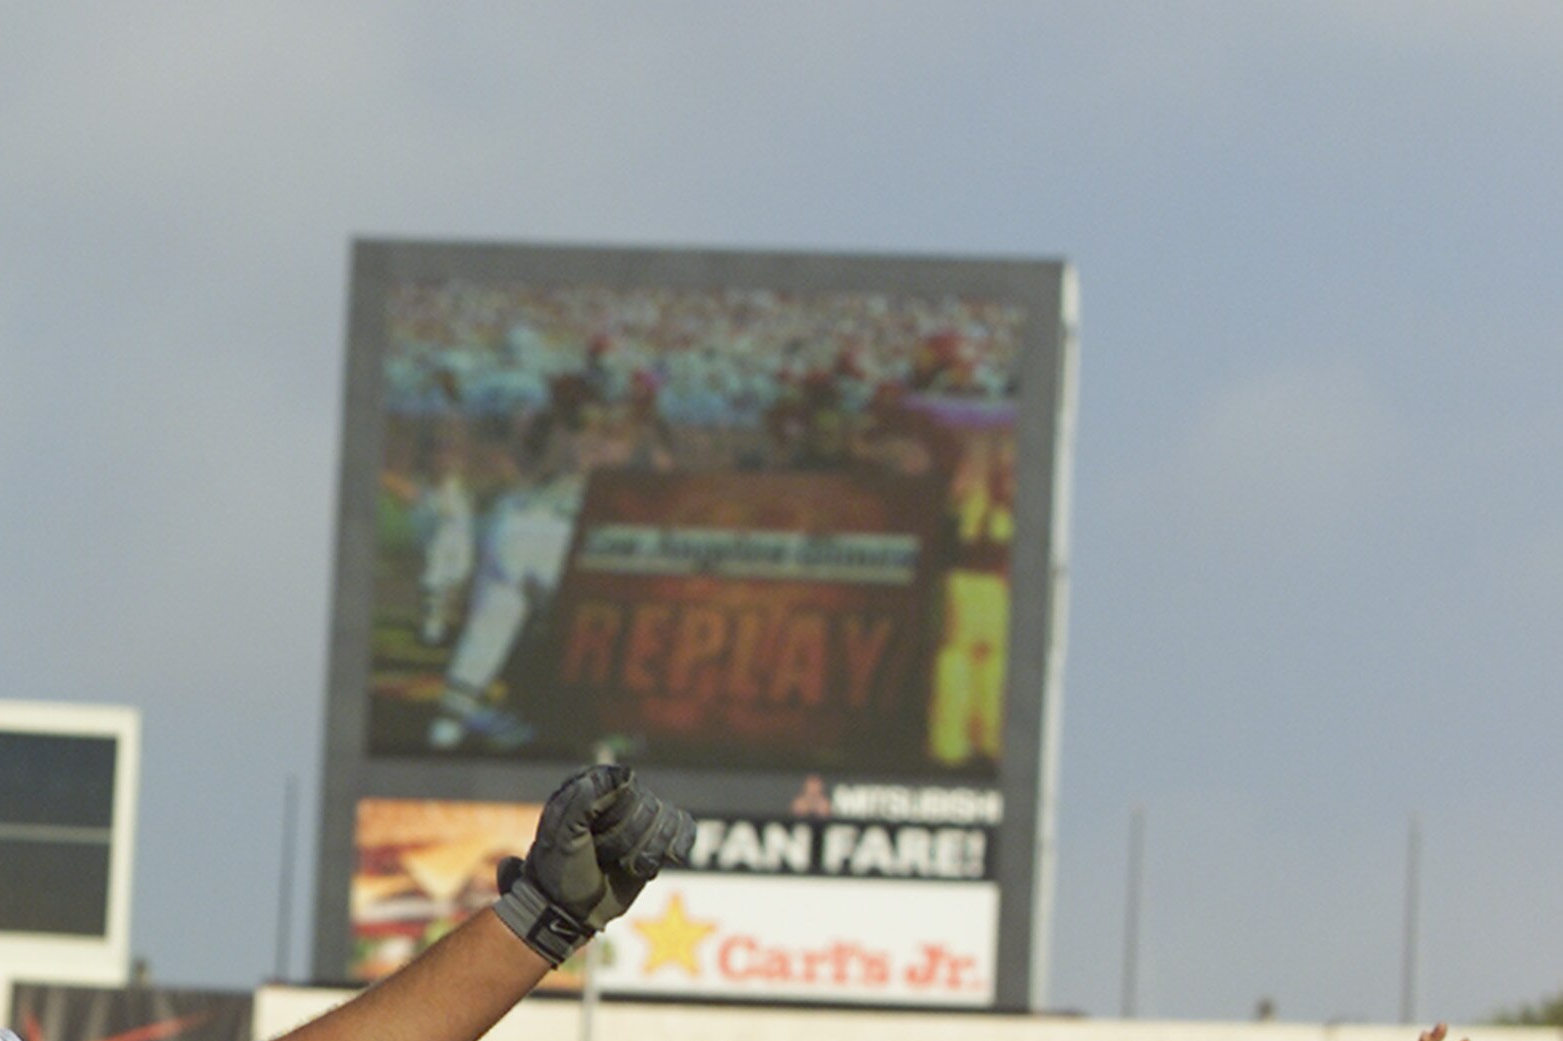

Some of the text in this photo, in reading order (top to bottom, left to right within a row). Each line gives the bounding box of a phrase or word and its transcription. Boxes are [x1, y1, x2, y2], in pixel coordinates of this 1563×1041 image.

[557, 600, 893, 707] REPLAY
[831, 783, 1005, 825] MITSUBISHI
[689, 819, 987, 878] FAN FARE!
[717, 936, 990, 989] Carl's Jr.
